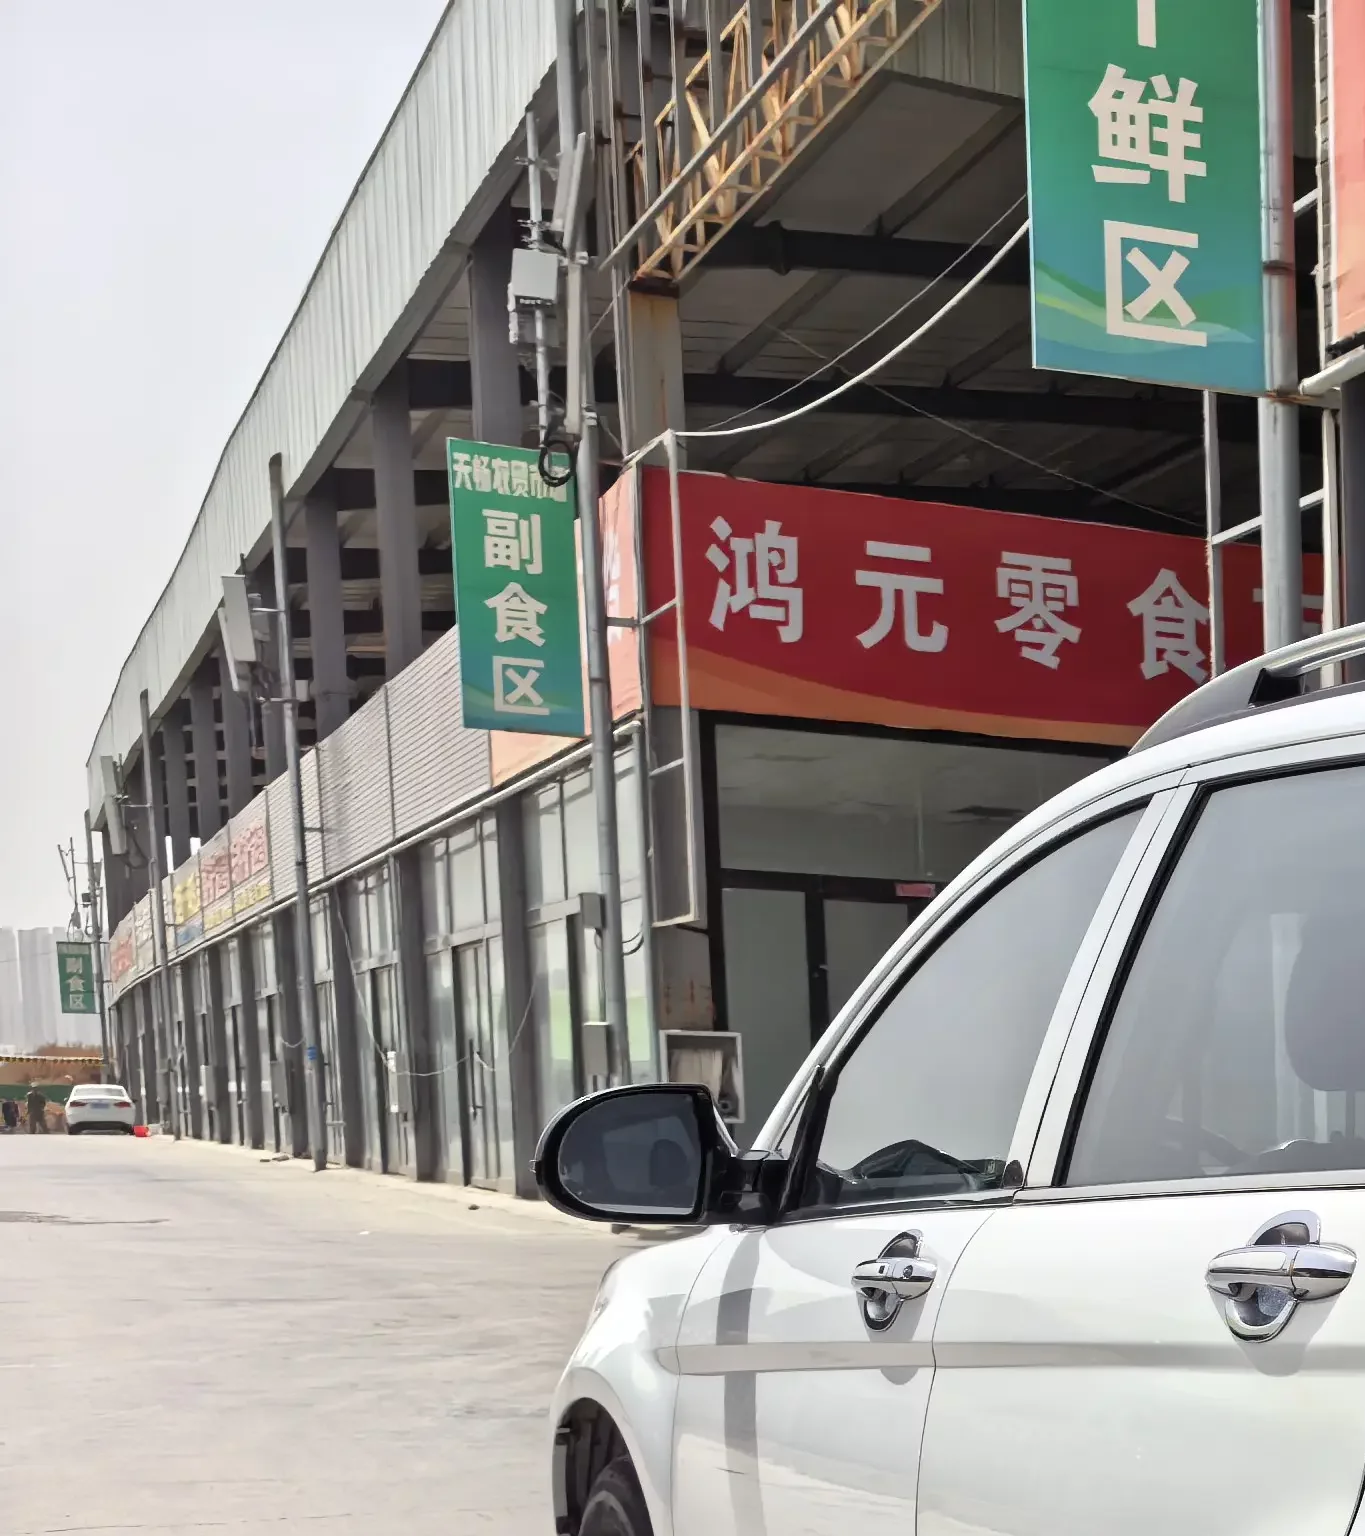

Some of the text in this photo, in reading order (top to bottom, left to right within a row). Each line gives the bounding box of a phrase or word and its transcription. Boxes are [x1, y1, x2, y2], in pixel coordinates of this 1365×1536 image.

[1088, 0, 1207, 348] 鲜区
[482, 509, 550, 716] 副食区
[708, 514, 1323, 685] 鸿元零食
